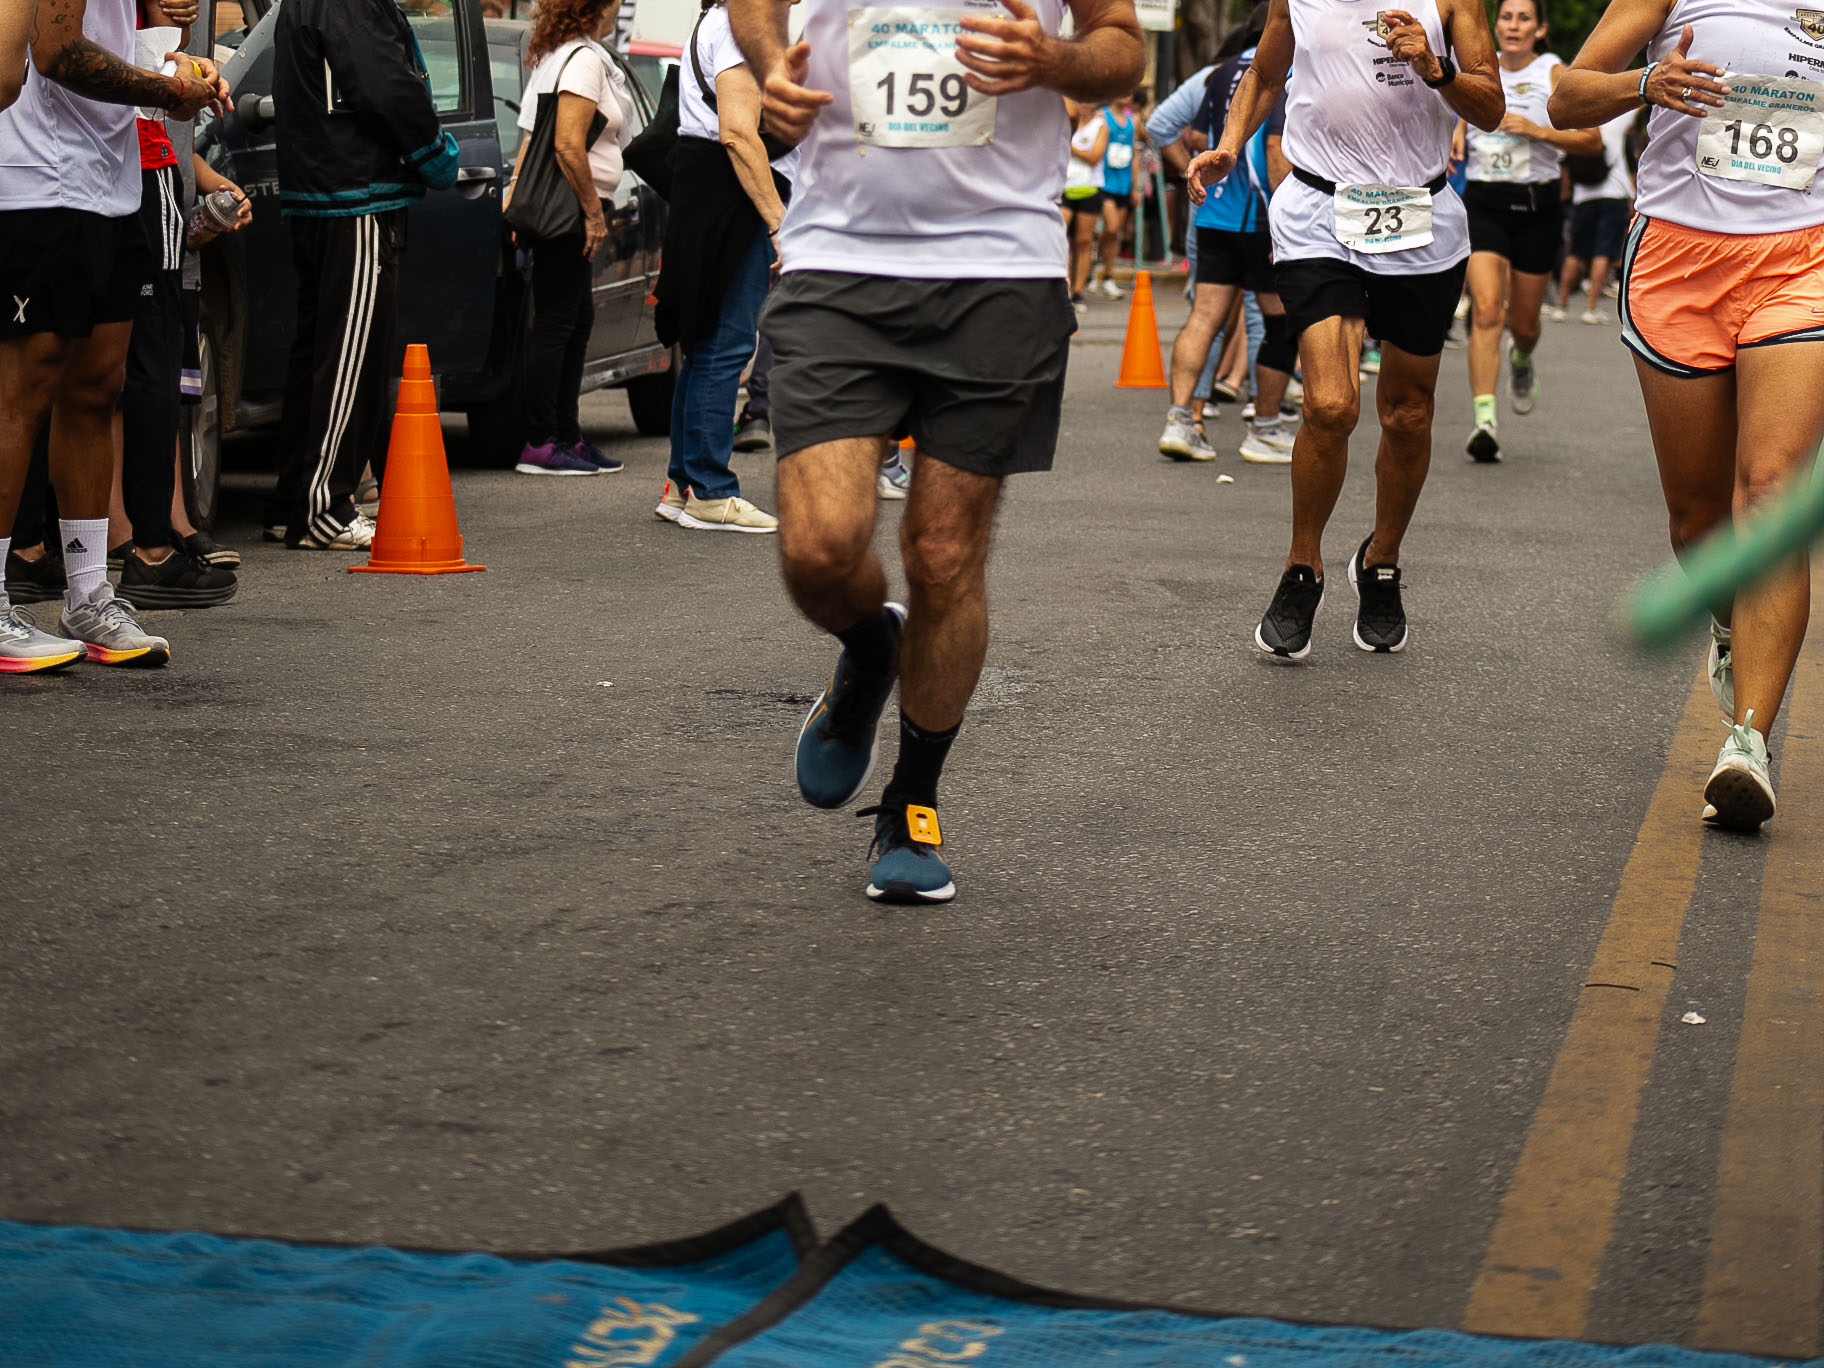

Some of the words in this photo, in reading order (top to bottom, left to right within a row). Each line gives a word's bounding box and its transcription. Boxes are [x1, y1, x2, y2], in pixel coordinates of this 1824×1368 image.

[871, 23, 890, 34] 40
[895, 23, 976, 35] MARATO
[1382, 27, 1393, 35] 4
[1783, 26, 1814, 48] EMPALME
[1387, 73, 1404, 81] Banco
[1387, 78, 1415, 88] Municipal
[877, 71, 969, 118] 159
[1731, 85, 1748, 94] 40
[1750, 86, 1816, 102] MARATON
[1724, 95, 1767, 107] EMPALME
[1768, 101, 1816, 112] GRANEROS
[1724, 119, 1799, 164] 168
[1490, 152, 1512, 169] 29
[1700, 156, 1720, 167] NEJ
[1731, 159, 1743, 169] DIA
[1743, 161, 1756, 171] DEL
[1757, 164, 1782, 174] VECINO
[244, 181, 281, 198] STE
[1364, 205, 1404, 236] 23
